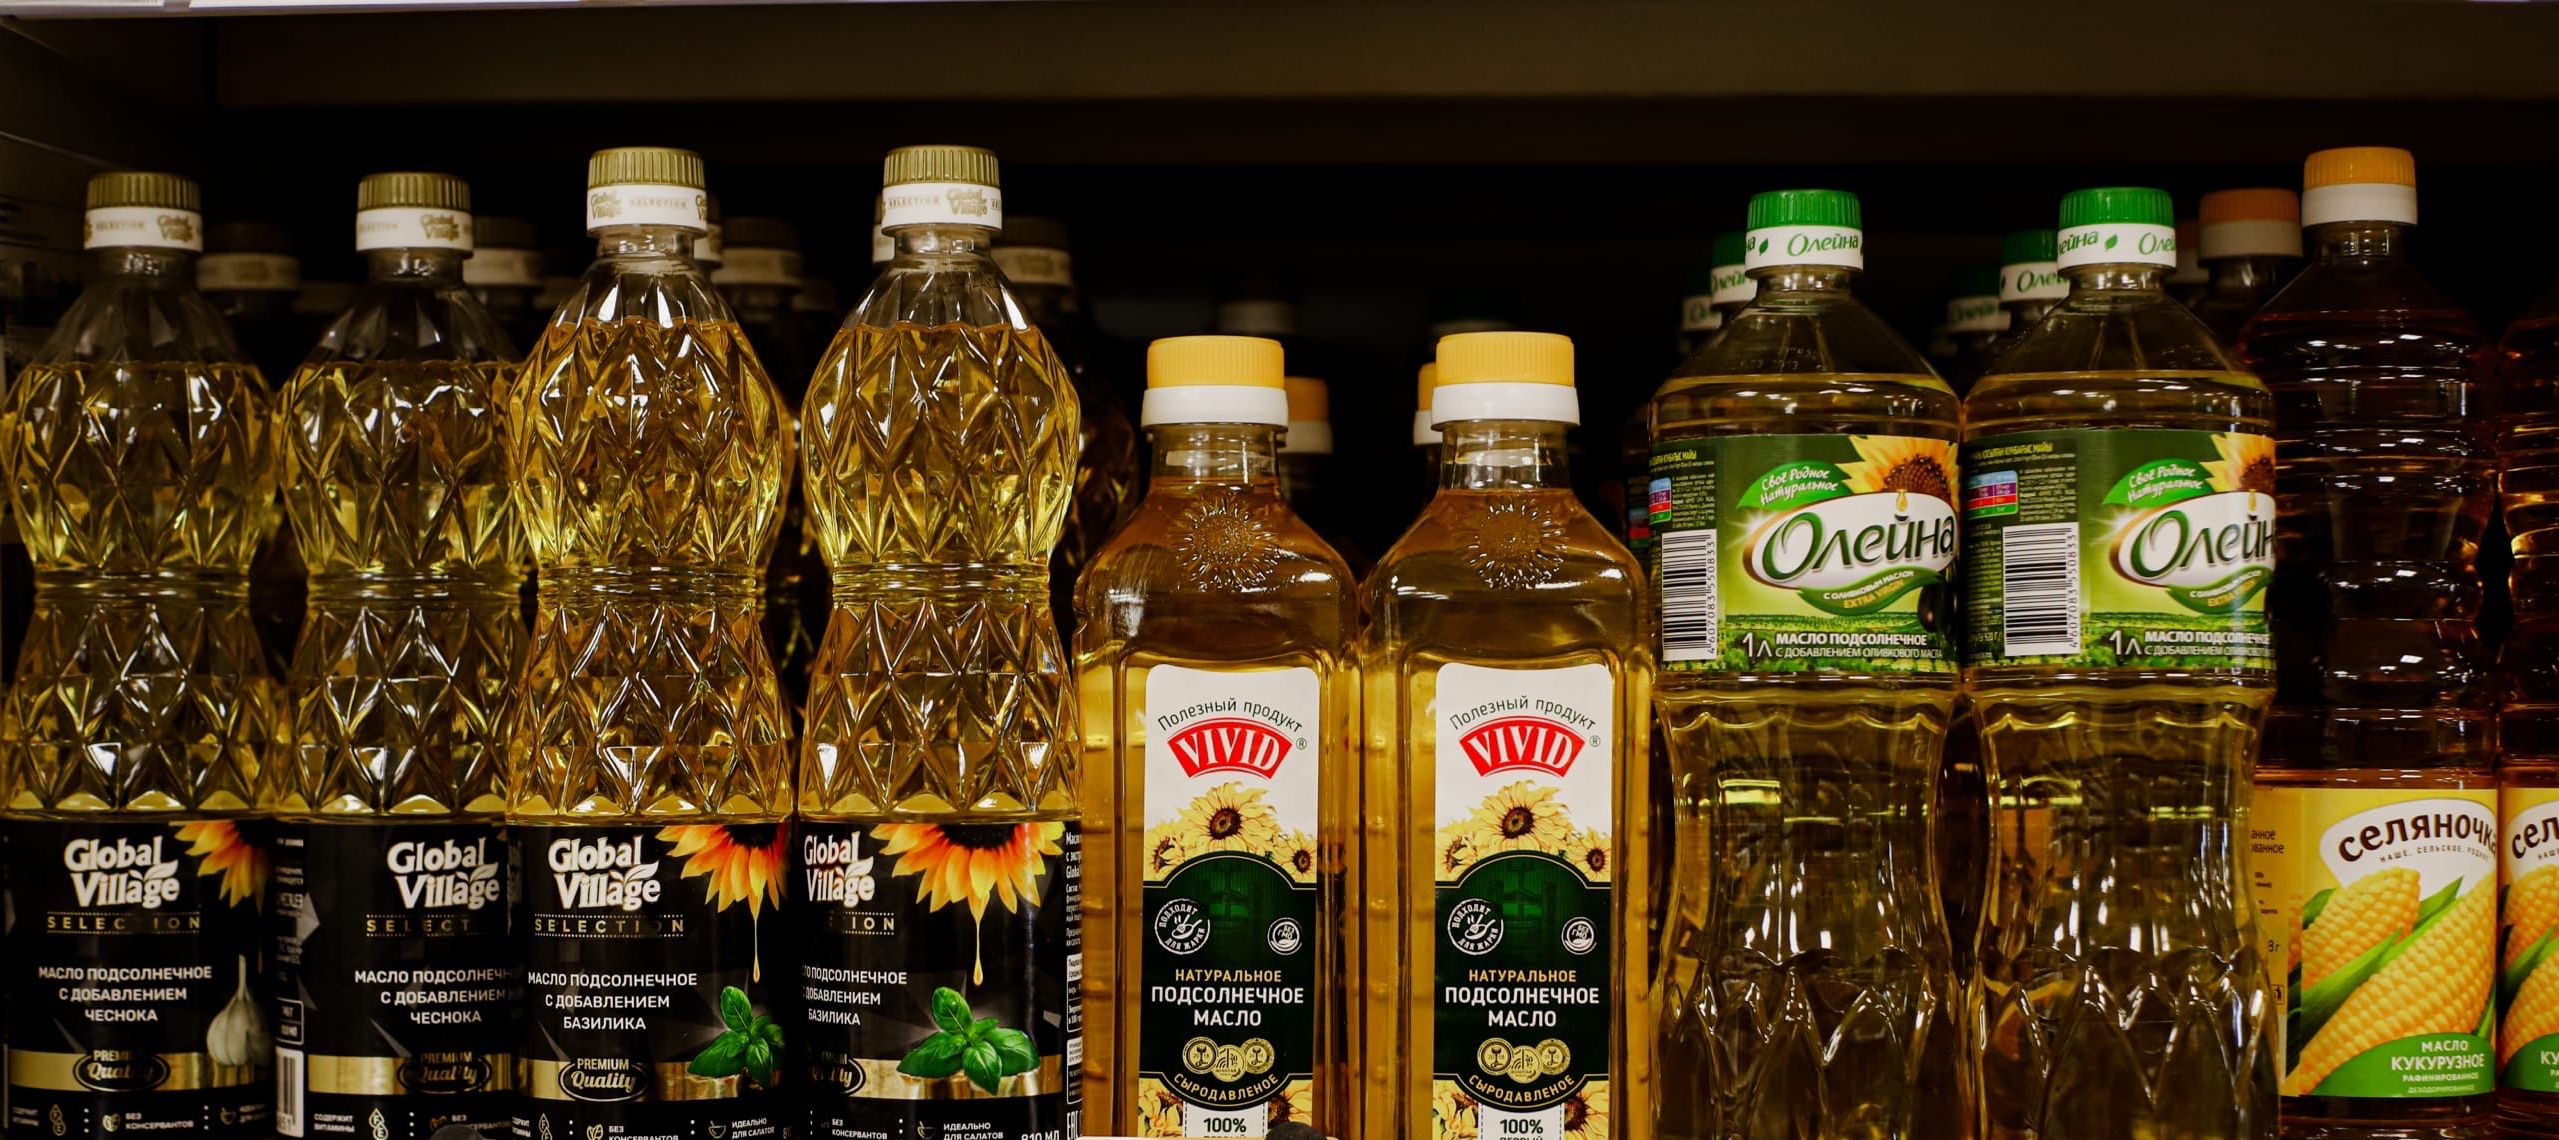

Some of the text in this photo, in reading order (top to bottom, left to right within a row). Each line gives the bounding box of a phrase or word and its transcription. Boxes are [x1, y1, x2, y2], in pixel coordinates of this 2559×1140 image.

[1787, 233, 1858, 257] Олейна
[1760, 482, 1838, 505] Натуральное
[1762, 511, 1955, 581] Олейна
[1776, 633, 1928, 648] МАСЛО ПОДСОЛНЕЧНОЕ
[2145, 631, 2194, 643] МАСЛО
[1776, 649, 1783, 658] С
[1784, 648, 1862, 659] ДОБАВЛЕНИЕМ
[1158, 698, 1303, 732] Полезный продукт
[1450, 696, 1596, 730] Полезный продукт
[1176, 727, 1280, 772] VIVID
[1468, 725, 1573, 769] VIVID
[64, 835, 164, 871] Global
[387, 837, 487, 874] Global
[548, 835, 643, 872] Global
[804, 831, 861, 866] Global
[71, 870, 180, 909] Village
[395, 872, 500, 910] Village
[554, 871, 661, 911] Village
[806, 868, 875, 908] Village
[47, 916, 200, 929] SELECION
[39, 966, 212, 981] МАСЛО ПОДСОЛНЕЧНОЕ
[355, 970, 409, 983] МАСЛО
[528, 973, 697, 988] МАСЛО ПОДСОЛНЕЧНОЕ
[811, 966, 907, 984] ПОДСОЛНЕЧНОЕ
[1175, 968, 1282, 982] НАТУРАЛЬНОЕ
[1469, 969, 1577, 982] НАТУРАЛЬНОЕ
[59, 988, 187, 1002] С ДОБАВЛЕНИЕМ
[381, 990, 507, 1006] С ДОБАВЛЕНИЕМ
[545, 994, 670, 1009] С ДОБАВЛЕНИЕМ
[805, 987, 881, 1005] ДОБАВЛЕНИЕМ
[1151, 986, 1304, 1005] ПОДСОЛНЕЧНОЕ
[1445, 986, 1599, 1006] ПОДСОЛНЕЧНОЕ
[85, 1009, 158, 1021] ЧЕСНОКА
[410, 1011, 482, 1024] ЧЕСНОКА
[564, 1016, 646, 1030] БАЗИЛИКА
[808, 1007, 861, 1026] БАЗИЛИКА
[1194, 1010, 1262, 1027] МАСЛО
[1488, 1010, 1557, 1027] МАСЛО
[2421, 1040, 2469, 1053] МАСЛО
[420, 1051, 473, 1064] PREMIUM
[577, 1058, 629, 1071] PREMIUM
[2391, 1053, 2485, 1071] КУКУРУЗНОЕ
[570, 1070, 636, 1093] Quality
[1173, 1073, 1279, 1101] СЫРОДАВЛЕНОЕ
[1468, 1073, 1575, 1103] СЫРОДАВЛЕНОЕ
[608, 1125, 624, 1133] БЕЗ
[732, 1118, 767, 1128] ИДЕАЛЬНО
[943, 1122, 991, 1131] ИДЕАЛЬНО
[1203, 1118, 1247, 1133] 100%
[1500, 1119, 1544, 1134] 100%
